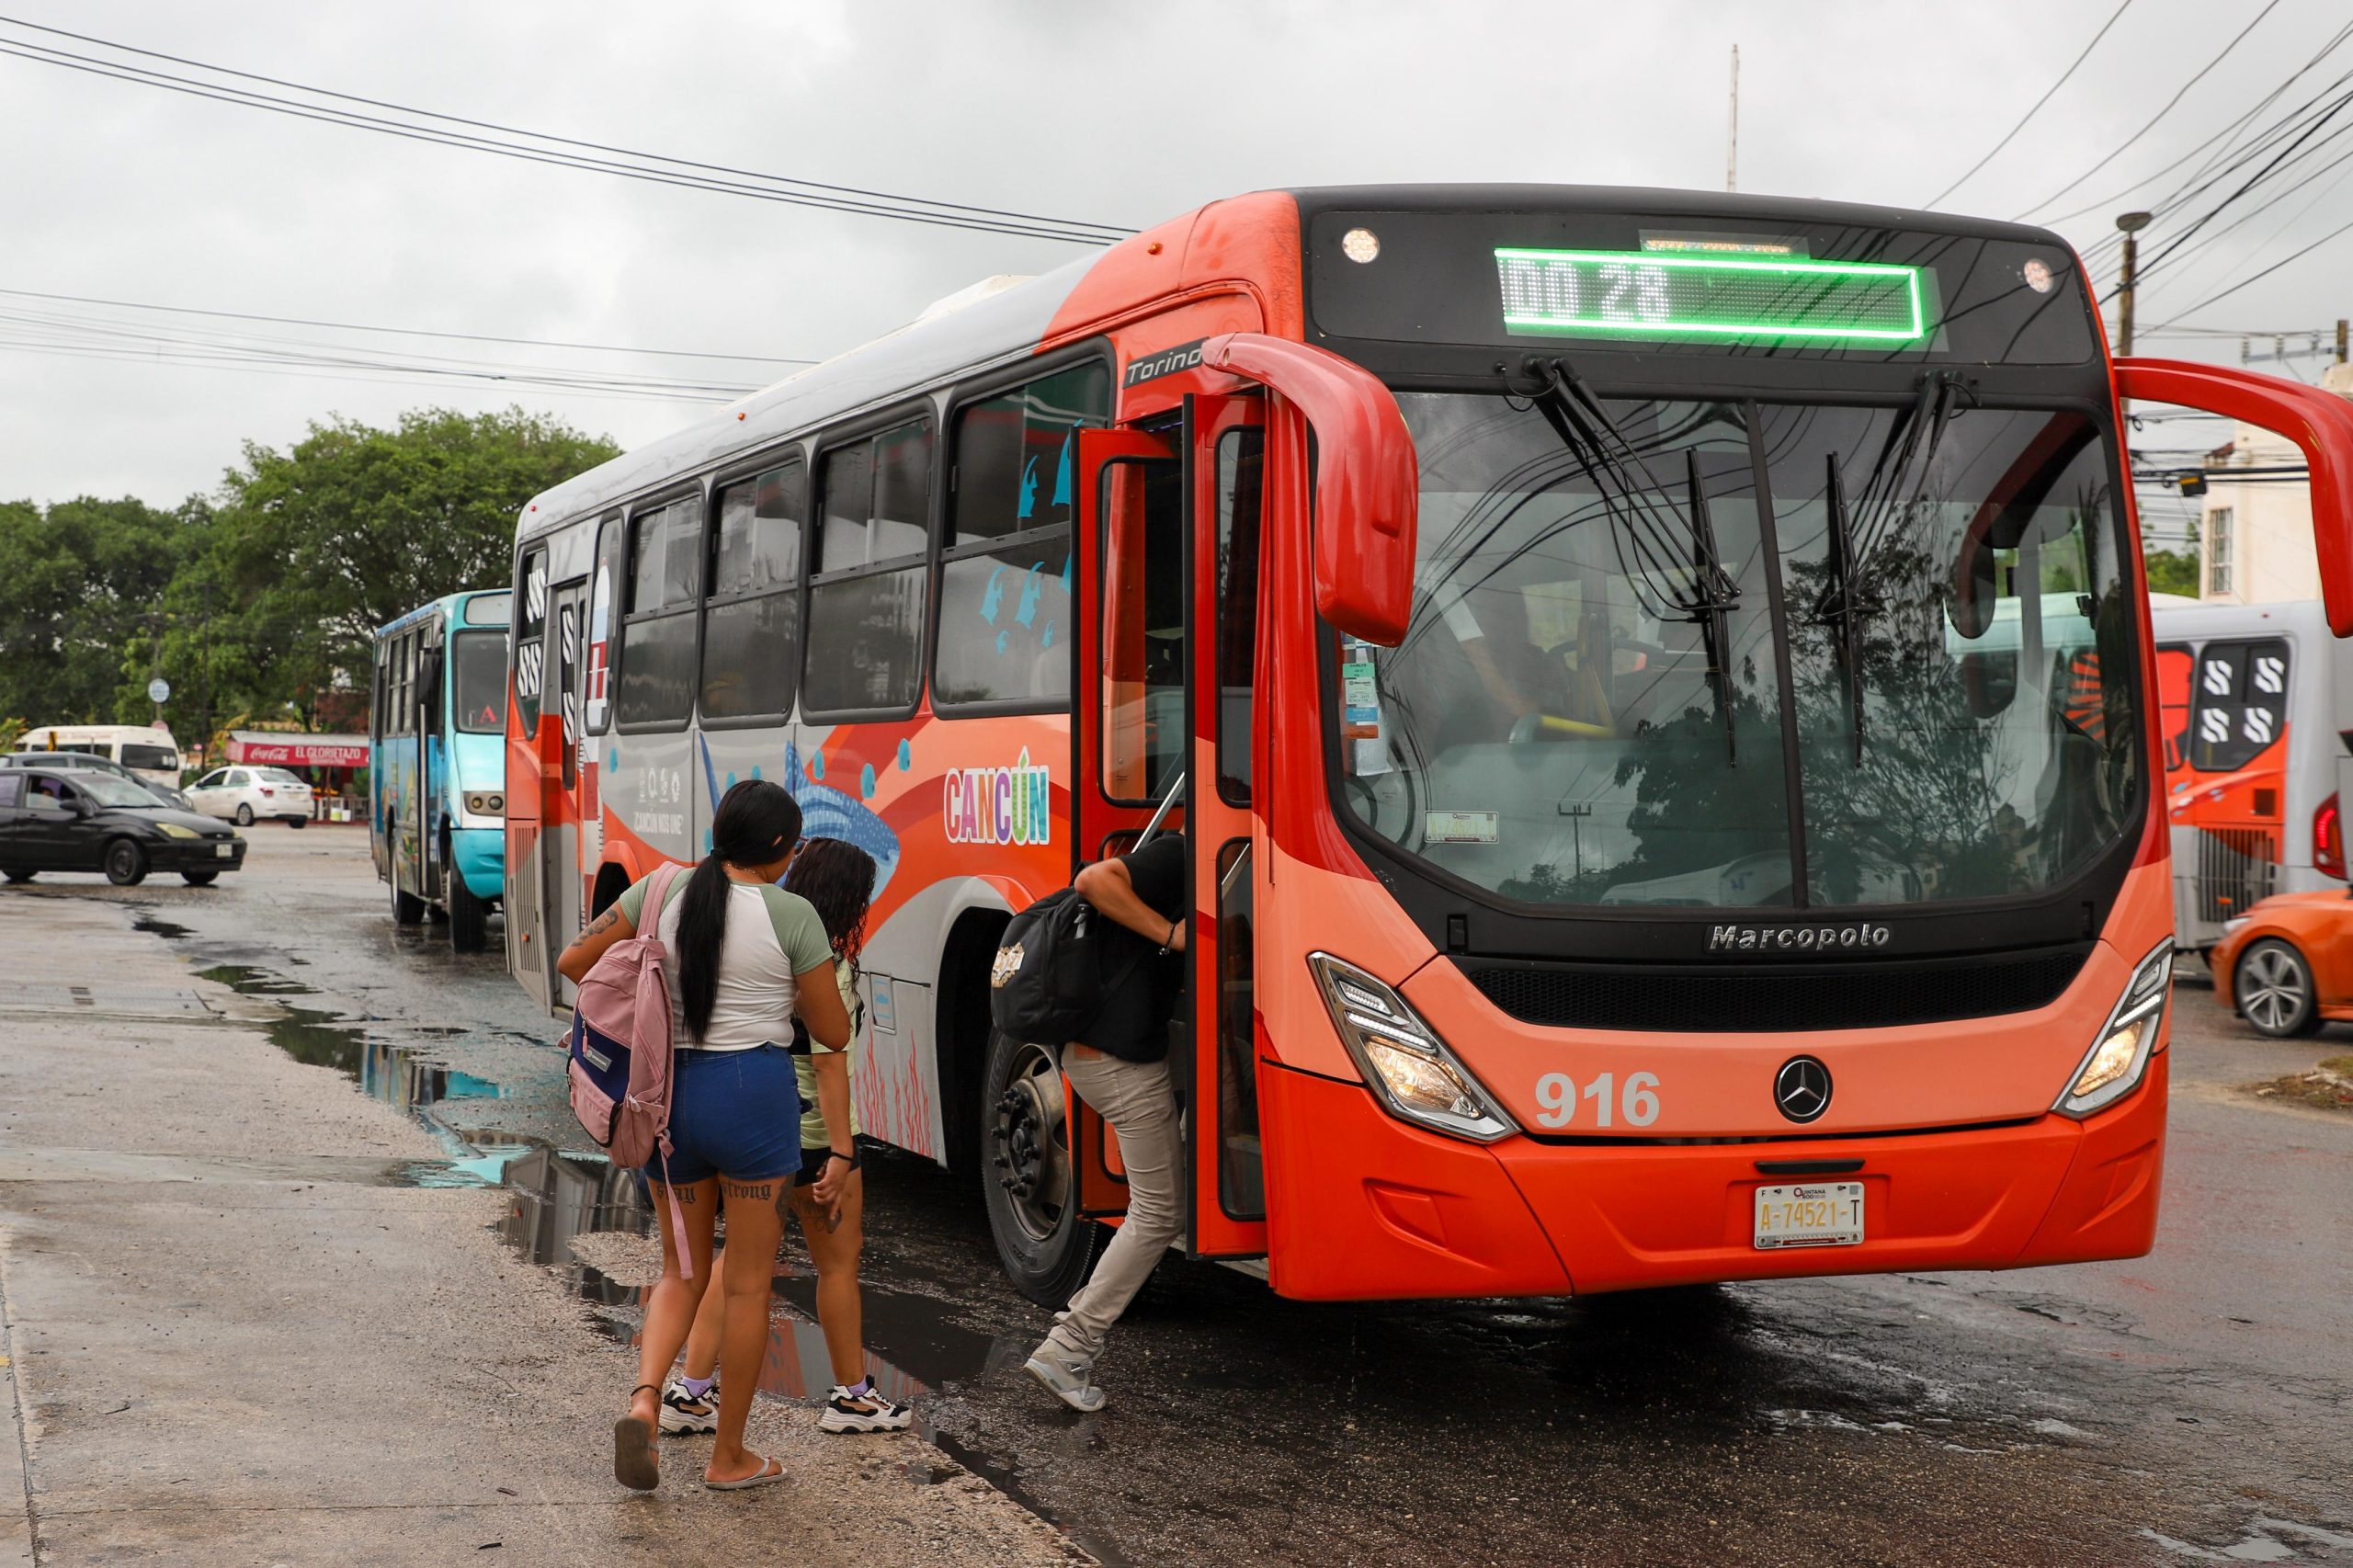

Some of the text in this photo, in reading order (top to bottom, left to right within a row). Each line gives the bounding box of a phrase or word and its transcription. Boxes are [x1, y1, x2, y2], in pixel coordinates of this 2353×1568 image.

[1598, 263, 1670, 322] 28
[1127, 348, 1203, 383] Torino
[478, 704, 499, 722] A
[250, 746, 290, 761] Coca-Cola
[295, 746, 305, 757] EL
[306, 746, 361, 759] GLORIETAZO
[944, 745, 1050, 846] CANCÚN
[1709, 924, 1890, 951] Marcopolo
[1536, 1071, 1661, 1129] 916
[721, 1182, 772, 1201] strong
[1793, 1187, 1826, 1198] QUINTANA
[1760, 1198, 1860, 1232] A-74521-T
